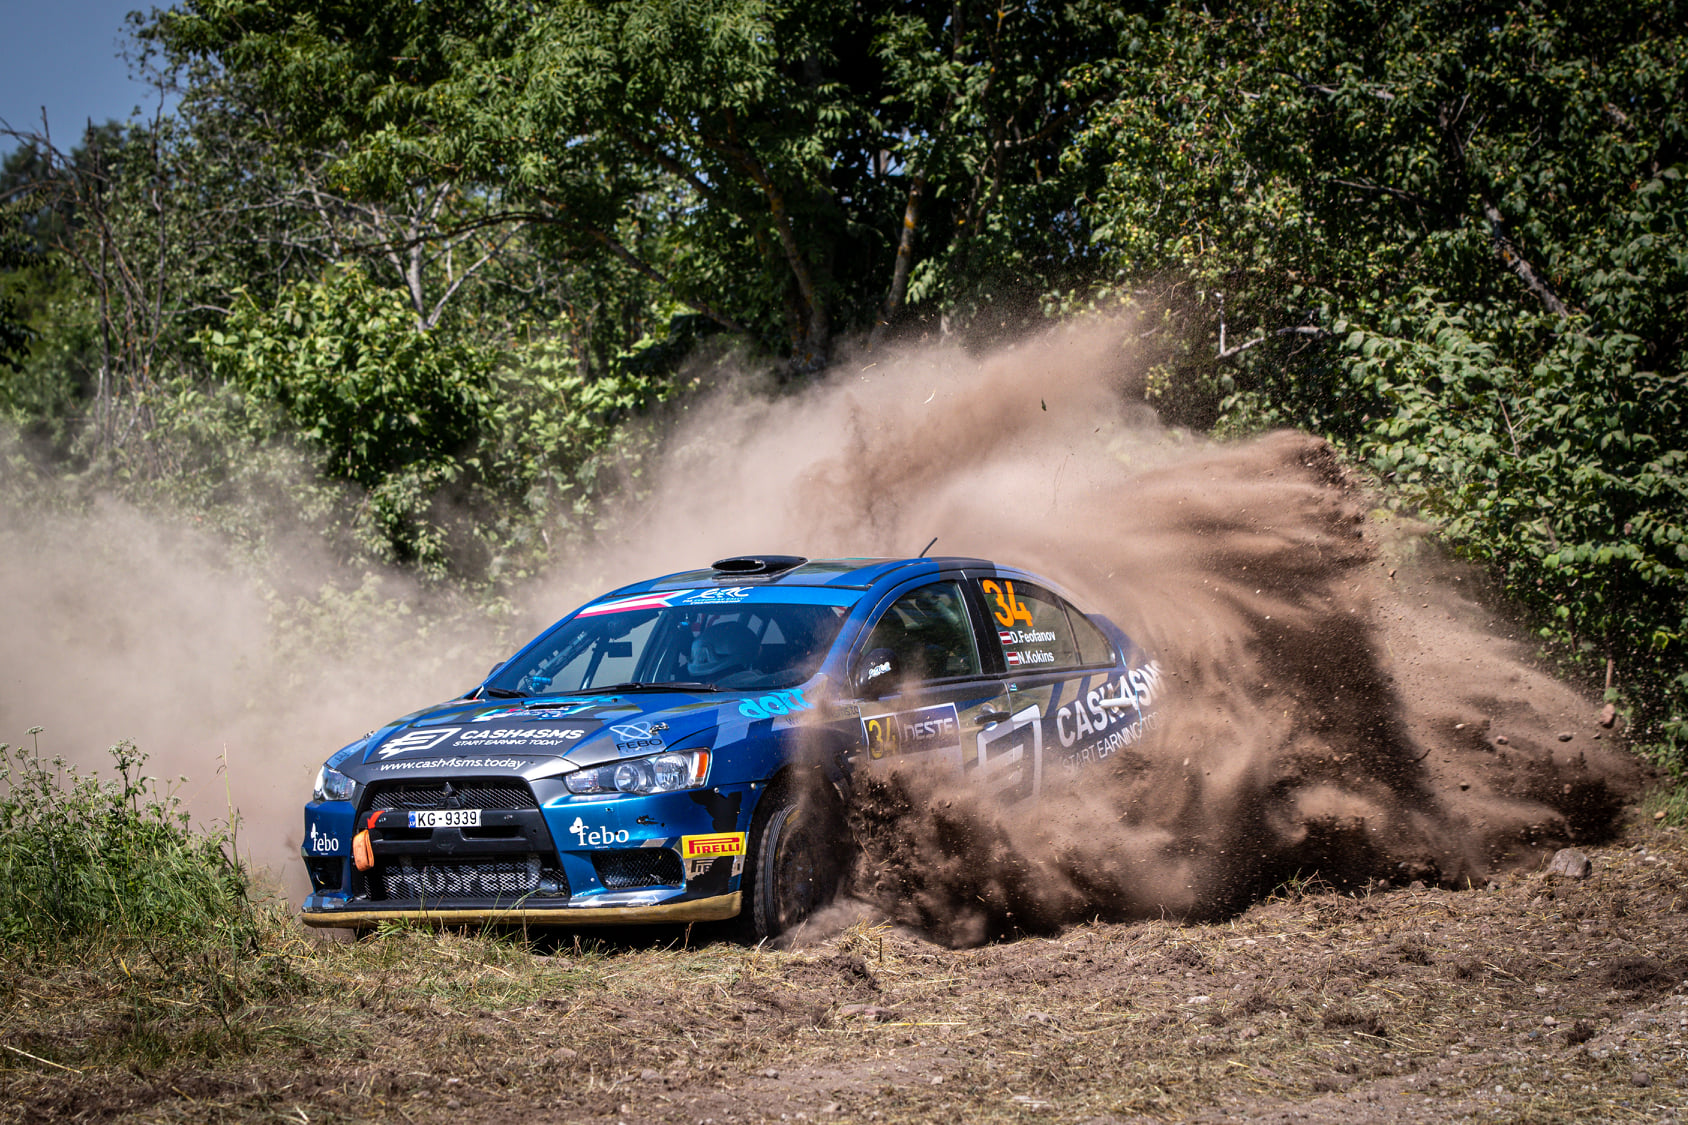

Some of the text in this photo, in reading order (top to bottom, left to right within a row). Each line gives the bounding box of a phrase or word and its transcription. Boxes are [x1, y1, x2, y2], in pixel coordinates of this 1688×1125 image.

[982, 579, 1034, 628] 34
[1010, 629, 1056, 644] D.Feofanov
[1017, 649, 1055, 665] N.Kokins
[452, 739, 484, 747] START
[529, 739, 564, 747] TODAY
[460, 729, 585, 740] CASH4SMS
[868, 717, 898, 759] 34
[1096, 721, 1143, 759] EARNING
[616, 738, 663, 751] FEBO
[380, 757, 527, 771] www.cash4sms.today
[417, 810, 477, 827] KG-9339
[312, 832, 339, 852] febo
[577, 825, 630, 846] febo
[688, 837, 740, 855] PIRELLI
